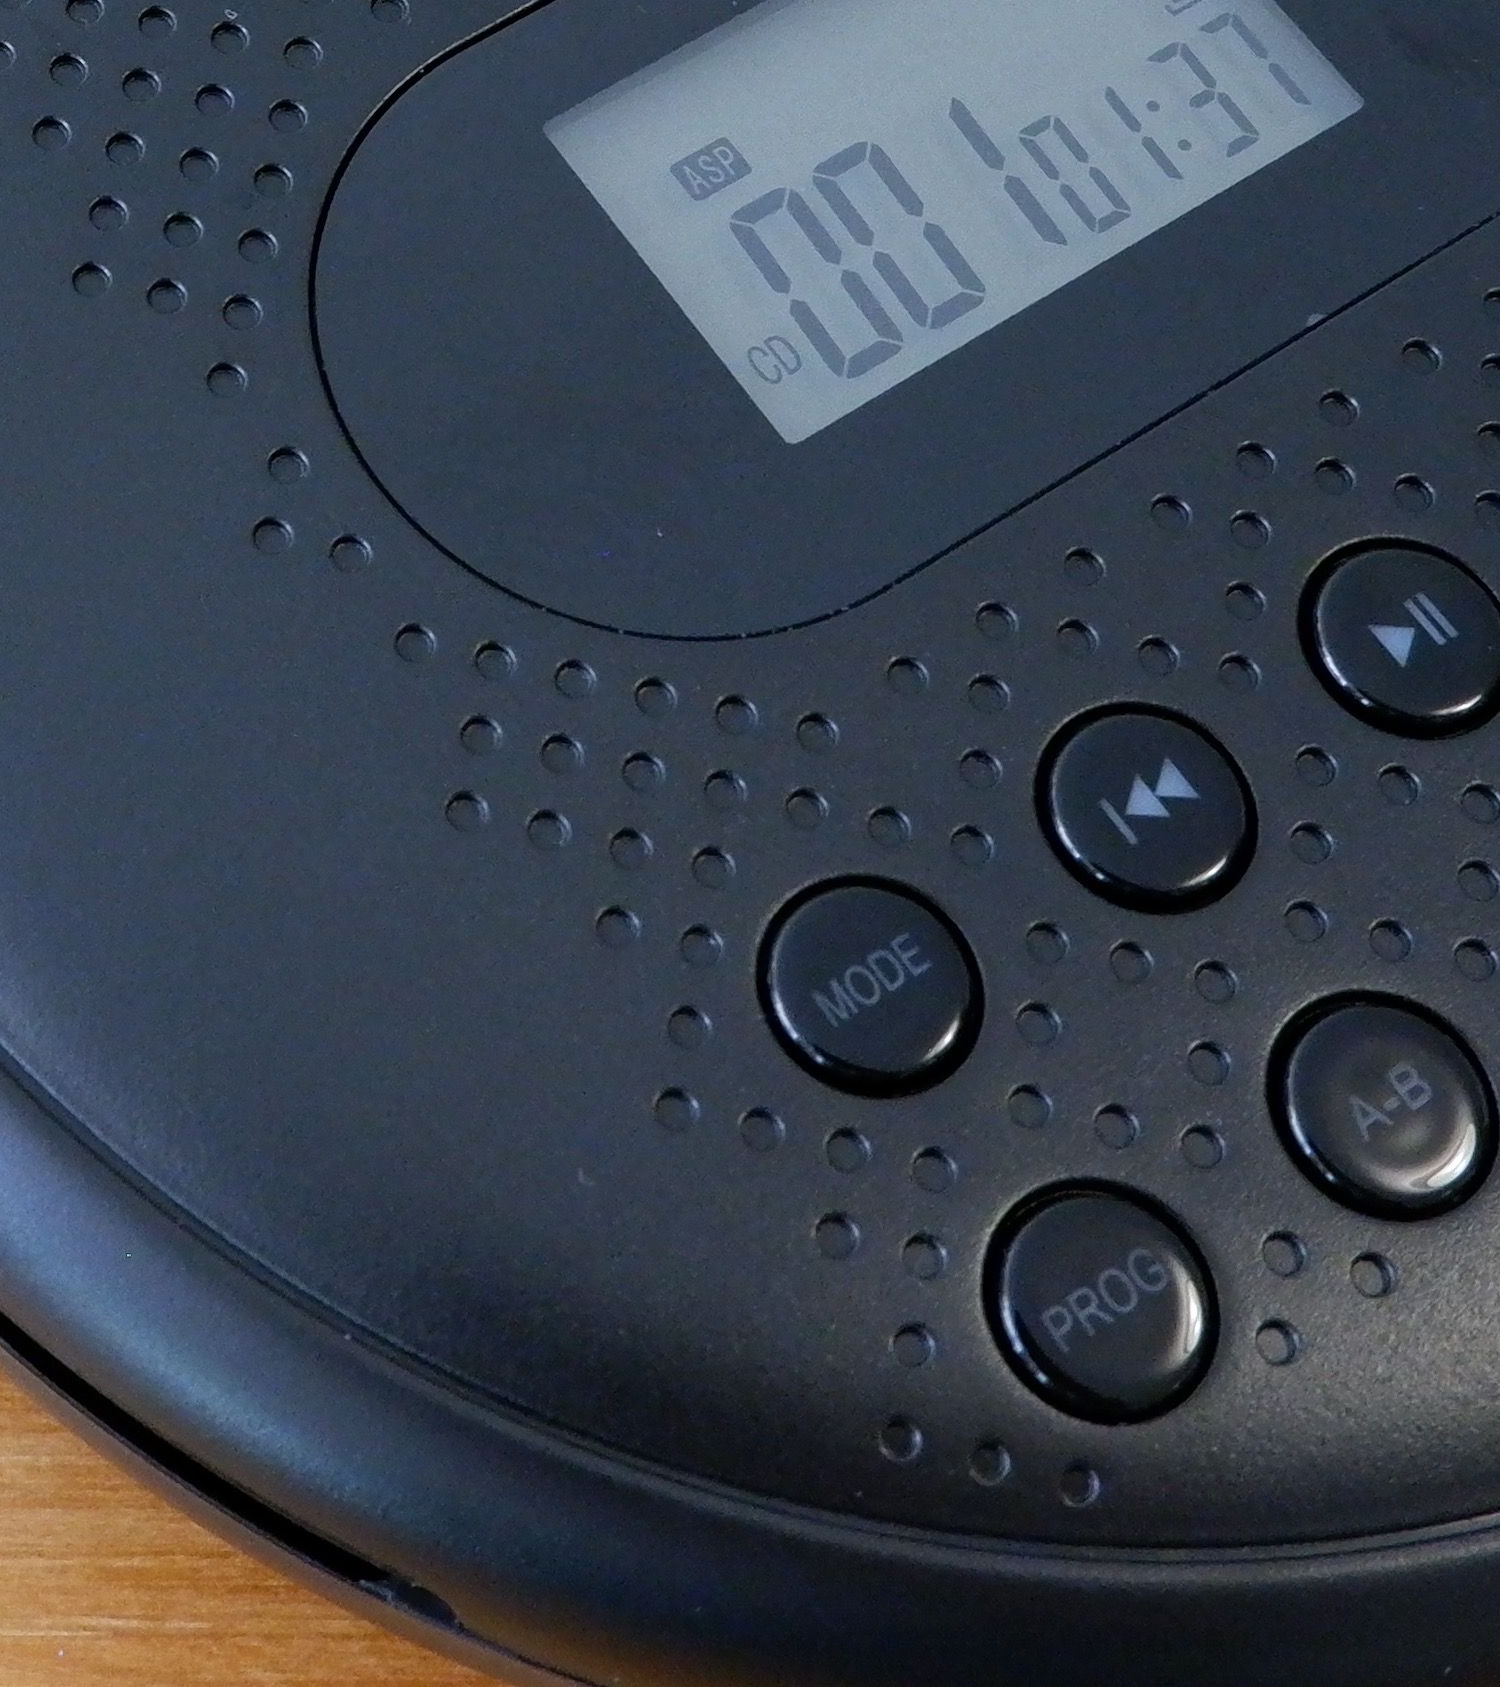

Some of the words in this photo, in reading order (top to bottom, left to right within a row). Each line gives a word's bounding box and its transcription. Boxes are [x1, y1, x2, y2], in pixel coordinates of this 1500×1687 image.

[681, 144, 739, 197] ASP
[728, 96, 1069, 379] 001
[1018, 12, 1312, 234] 01:37
[746, 334, 803, 385] CD
[811, 932, 933, 1028] MODE
[1350, 1063, 1433, 1142] A-B
[1040, 1248, 1168, 1353] PROG
